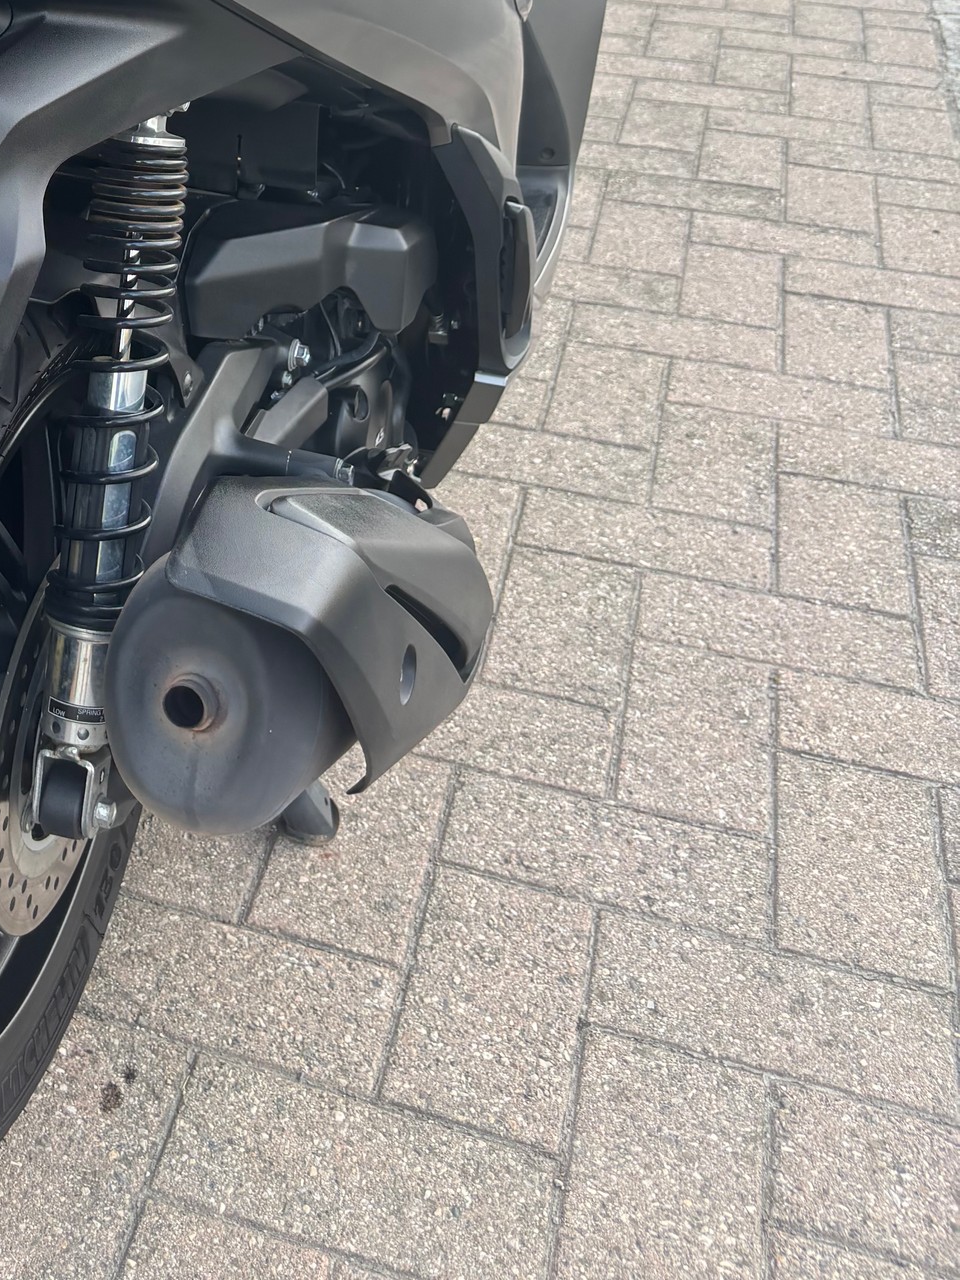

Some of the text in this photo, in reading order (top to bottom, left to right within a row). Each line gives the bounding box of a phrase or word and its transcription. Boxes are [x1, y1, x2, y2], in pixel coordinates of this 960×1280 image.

[52, 707, 66, 717] LOW
[77, 708, 101, 716] SPRING
[2, 926, 90, 1114] MICHELIN
